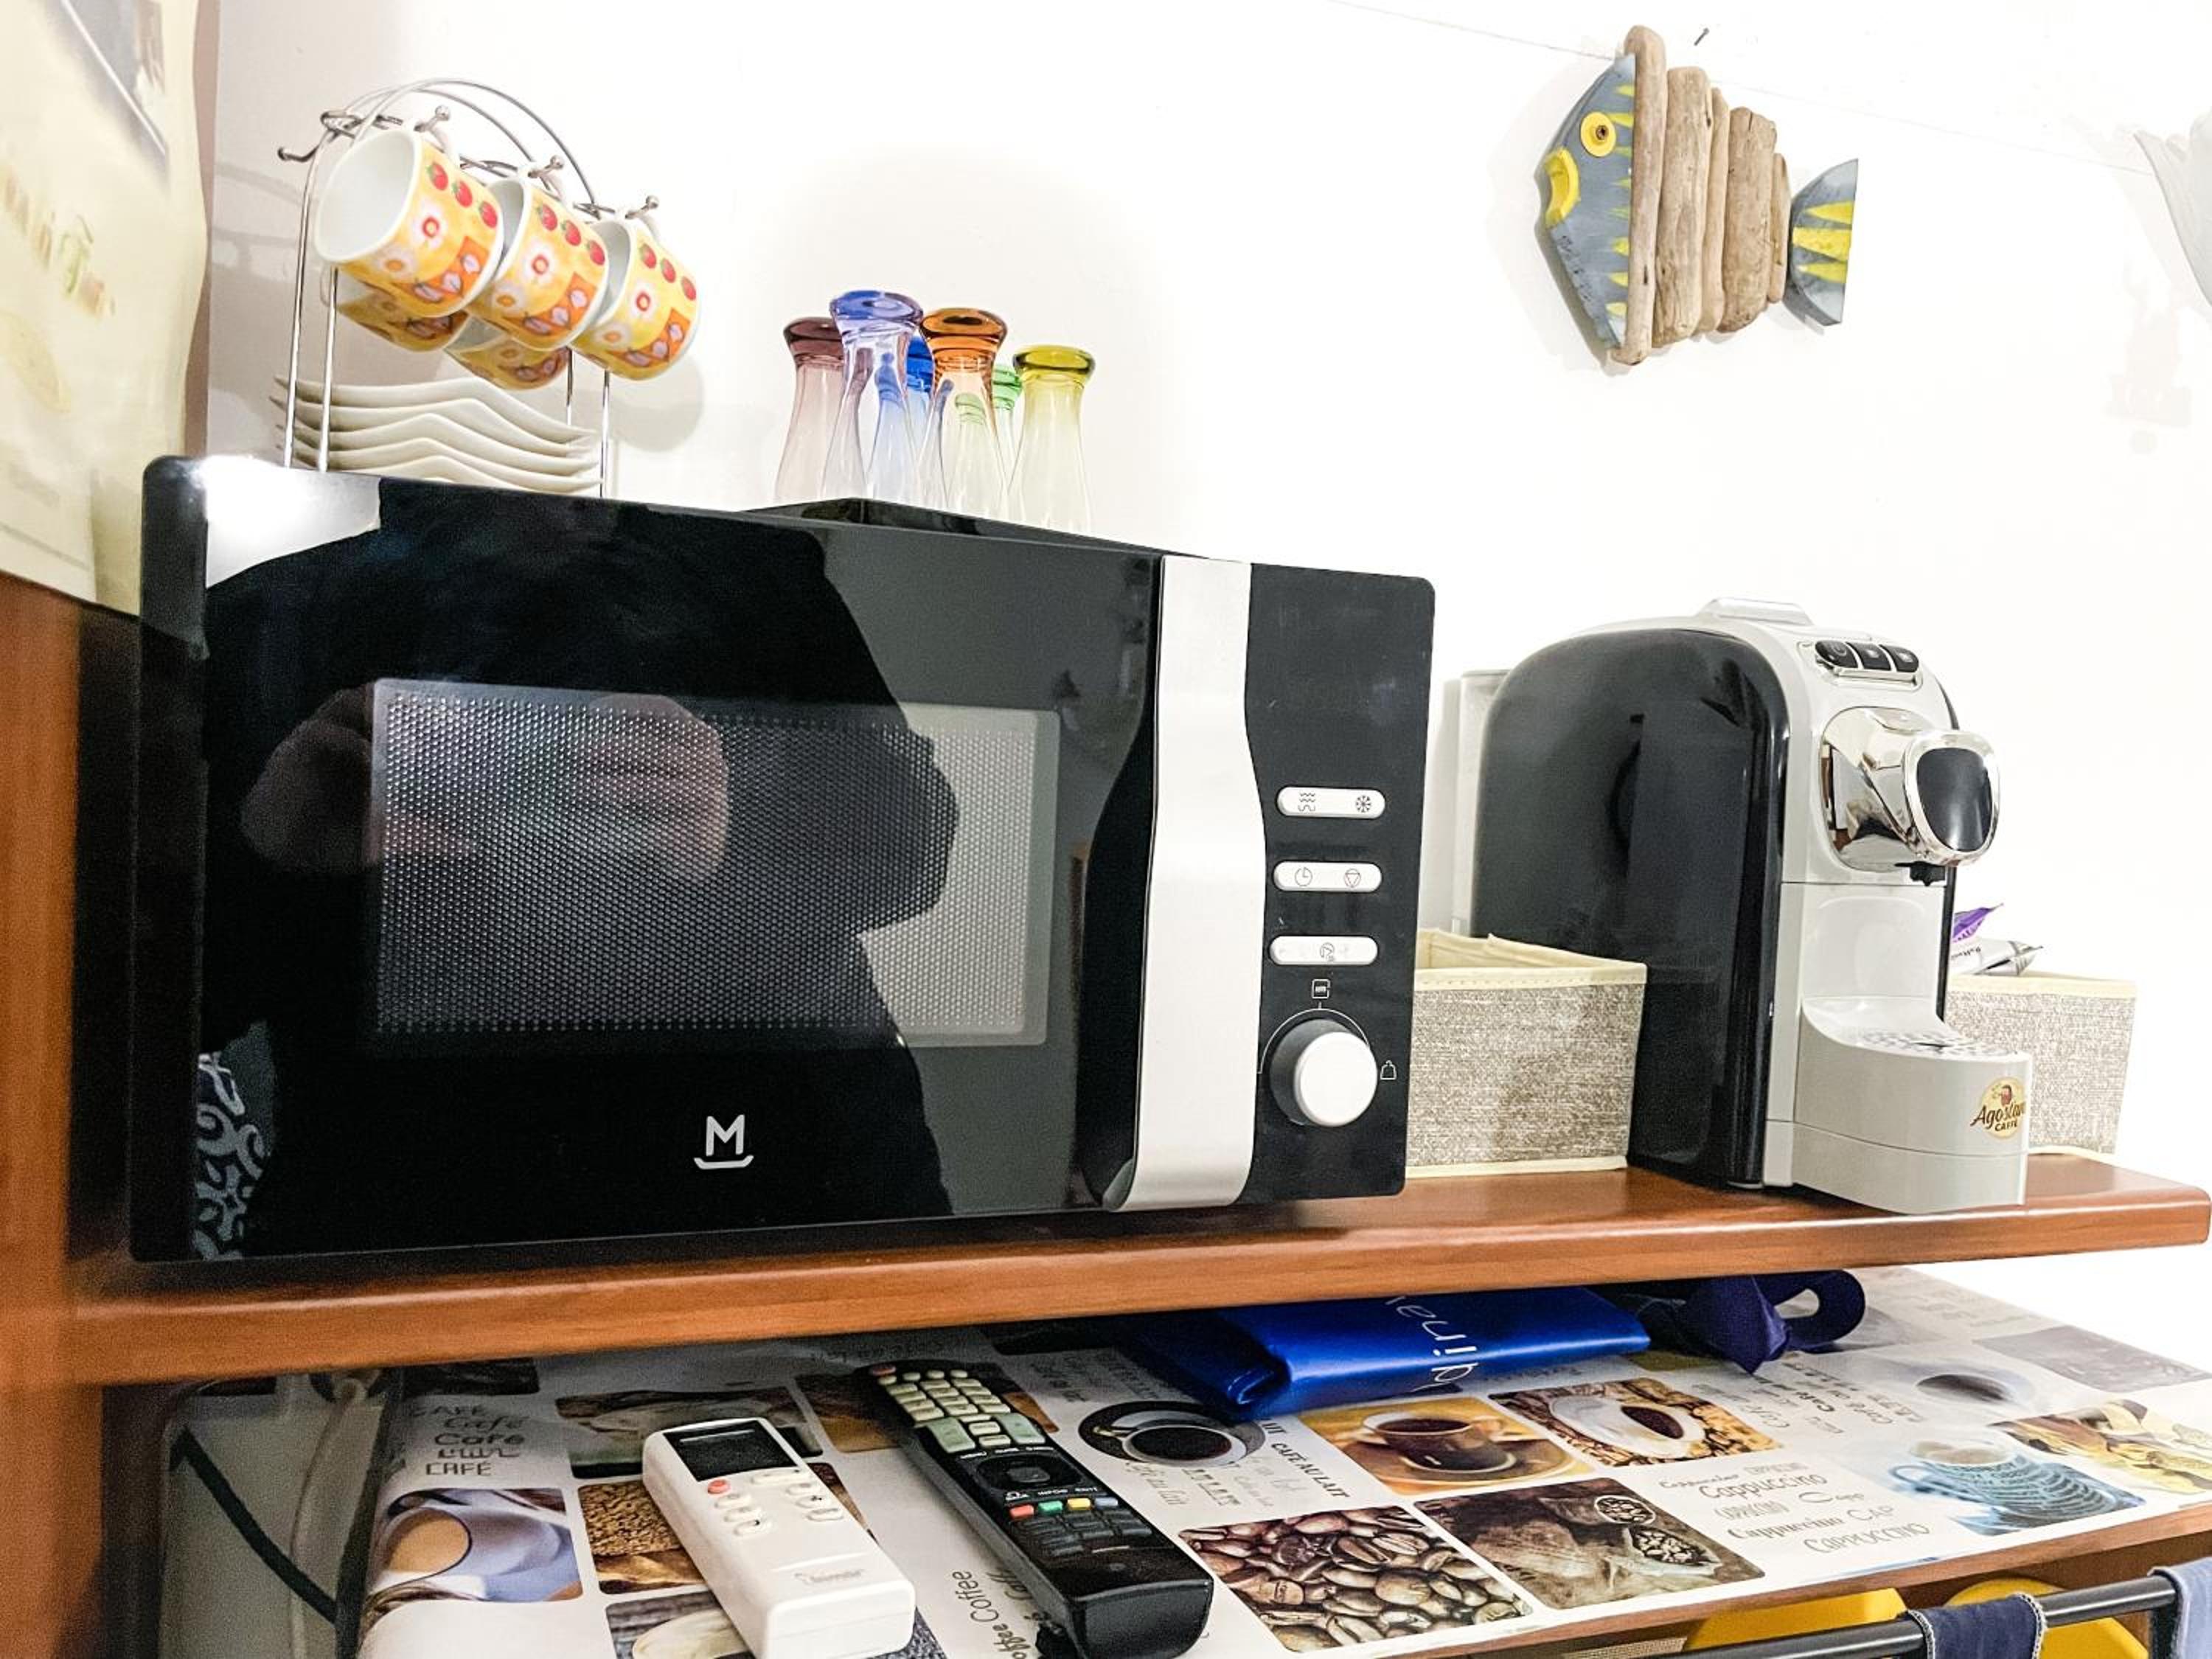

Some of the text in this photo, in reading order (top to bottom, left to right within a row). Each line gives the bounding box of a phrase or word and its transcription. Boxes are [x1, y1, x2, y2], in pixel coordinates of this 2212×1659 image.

[1698, 1473, 1828, 1500] Cappuccino
[951, 1571, 1000, 1623] Coffee
[992, 1623, 1032, 1659] offee
